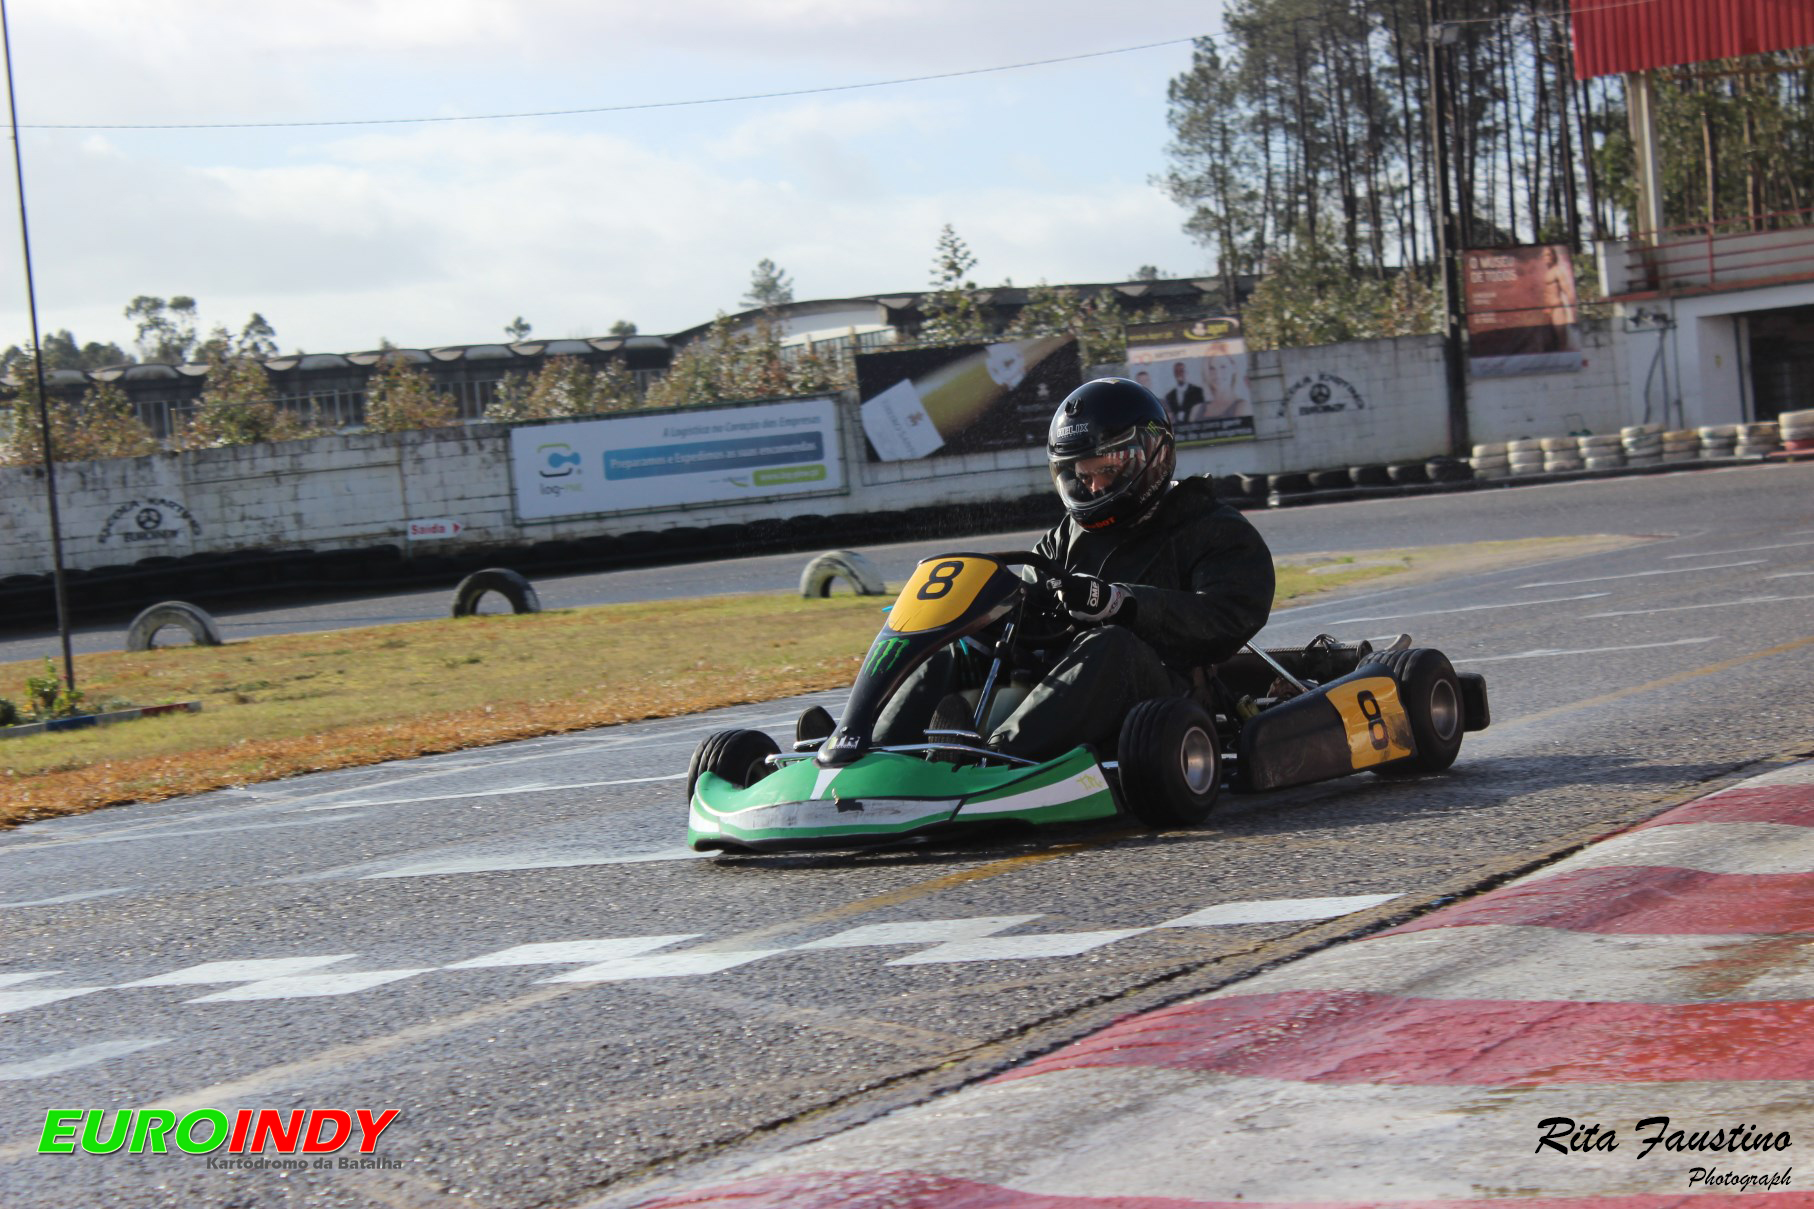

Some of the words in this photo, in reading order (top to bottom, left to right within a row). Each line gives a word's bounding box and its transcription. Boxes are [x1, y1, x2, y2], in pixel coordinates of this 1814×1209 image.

[917, 560, 965, 600] 8
[1089, 581, 1099, 607] OMP
[1357, 690, 1390, 750] 8
